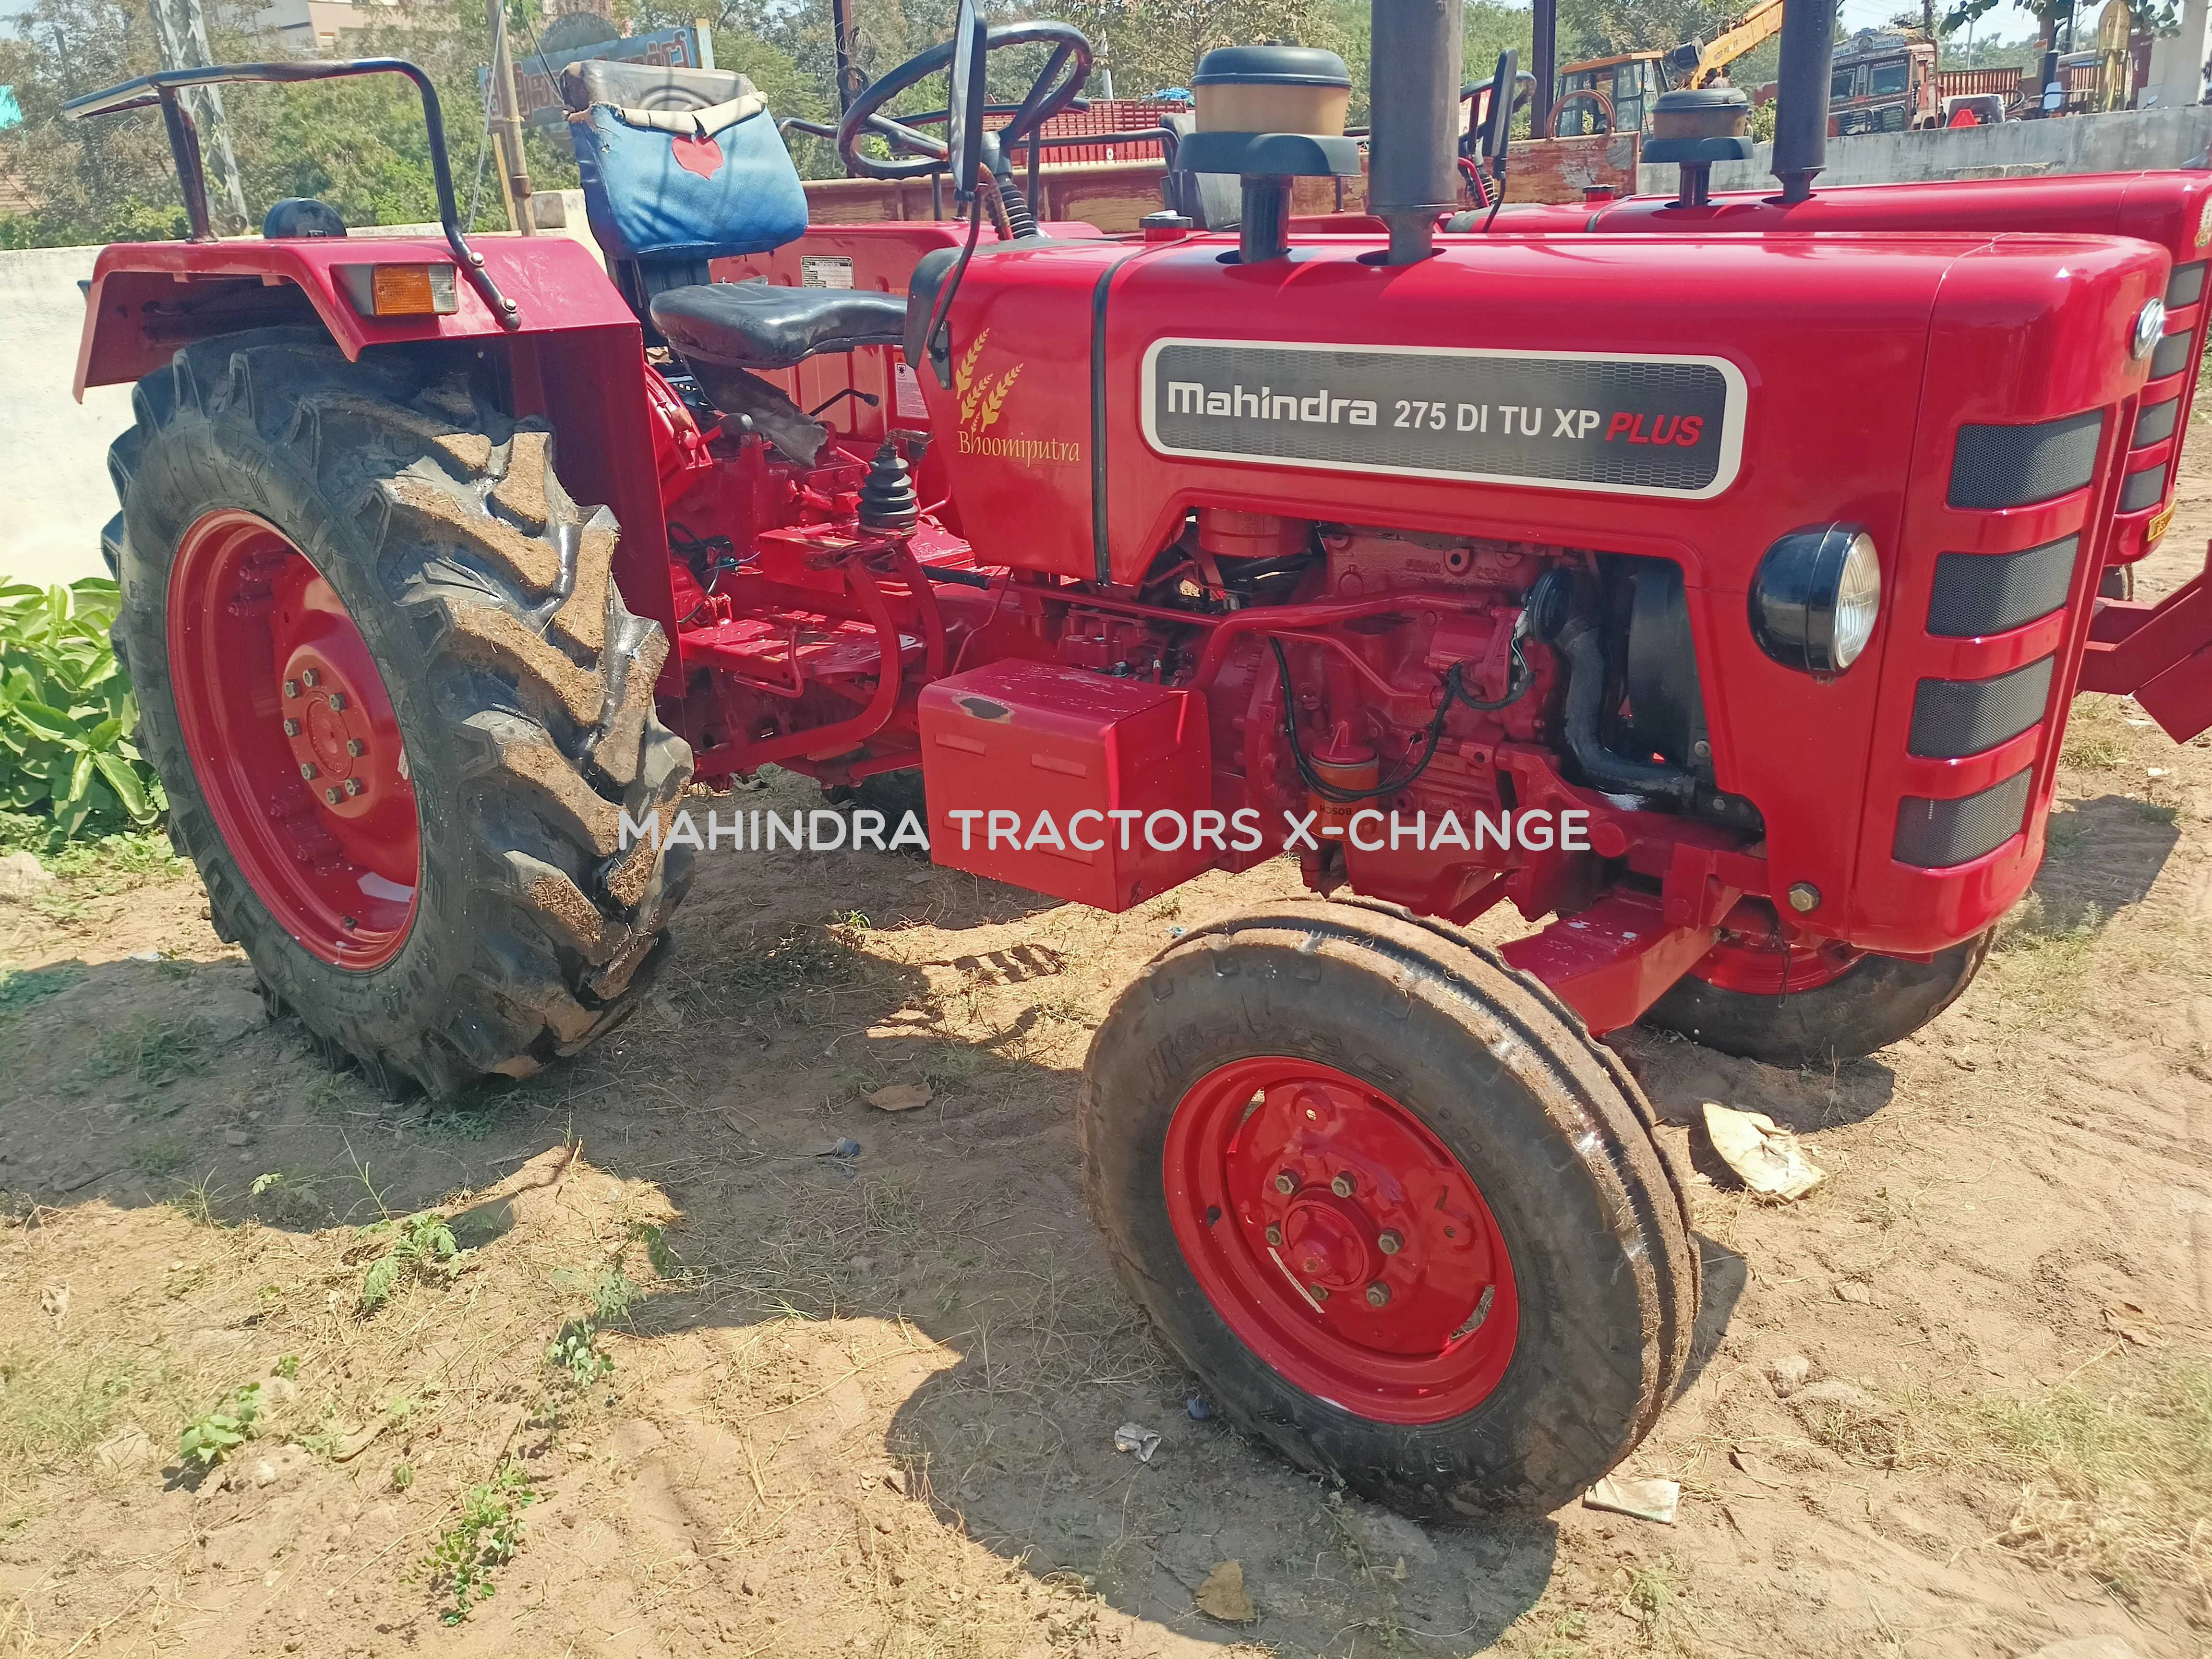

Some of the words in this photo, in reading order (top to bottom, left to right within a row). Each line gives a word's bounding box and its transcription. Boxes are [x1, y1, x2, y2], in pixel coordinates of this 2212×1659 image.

[1168, 381, 1377, 426] Mahindra
[1394, 400, 1446, 430] 275
[1456, 403, 1488, 433] DI
[1498, 405, 1542, 436] TU
[1551, 408, 1600, 439] XP
[1605, 411, 1704, 446] PLUS
[957, 430, 1081, 468] Bhoomiputra
[1320, 805, 1352, 816] BOSCH
